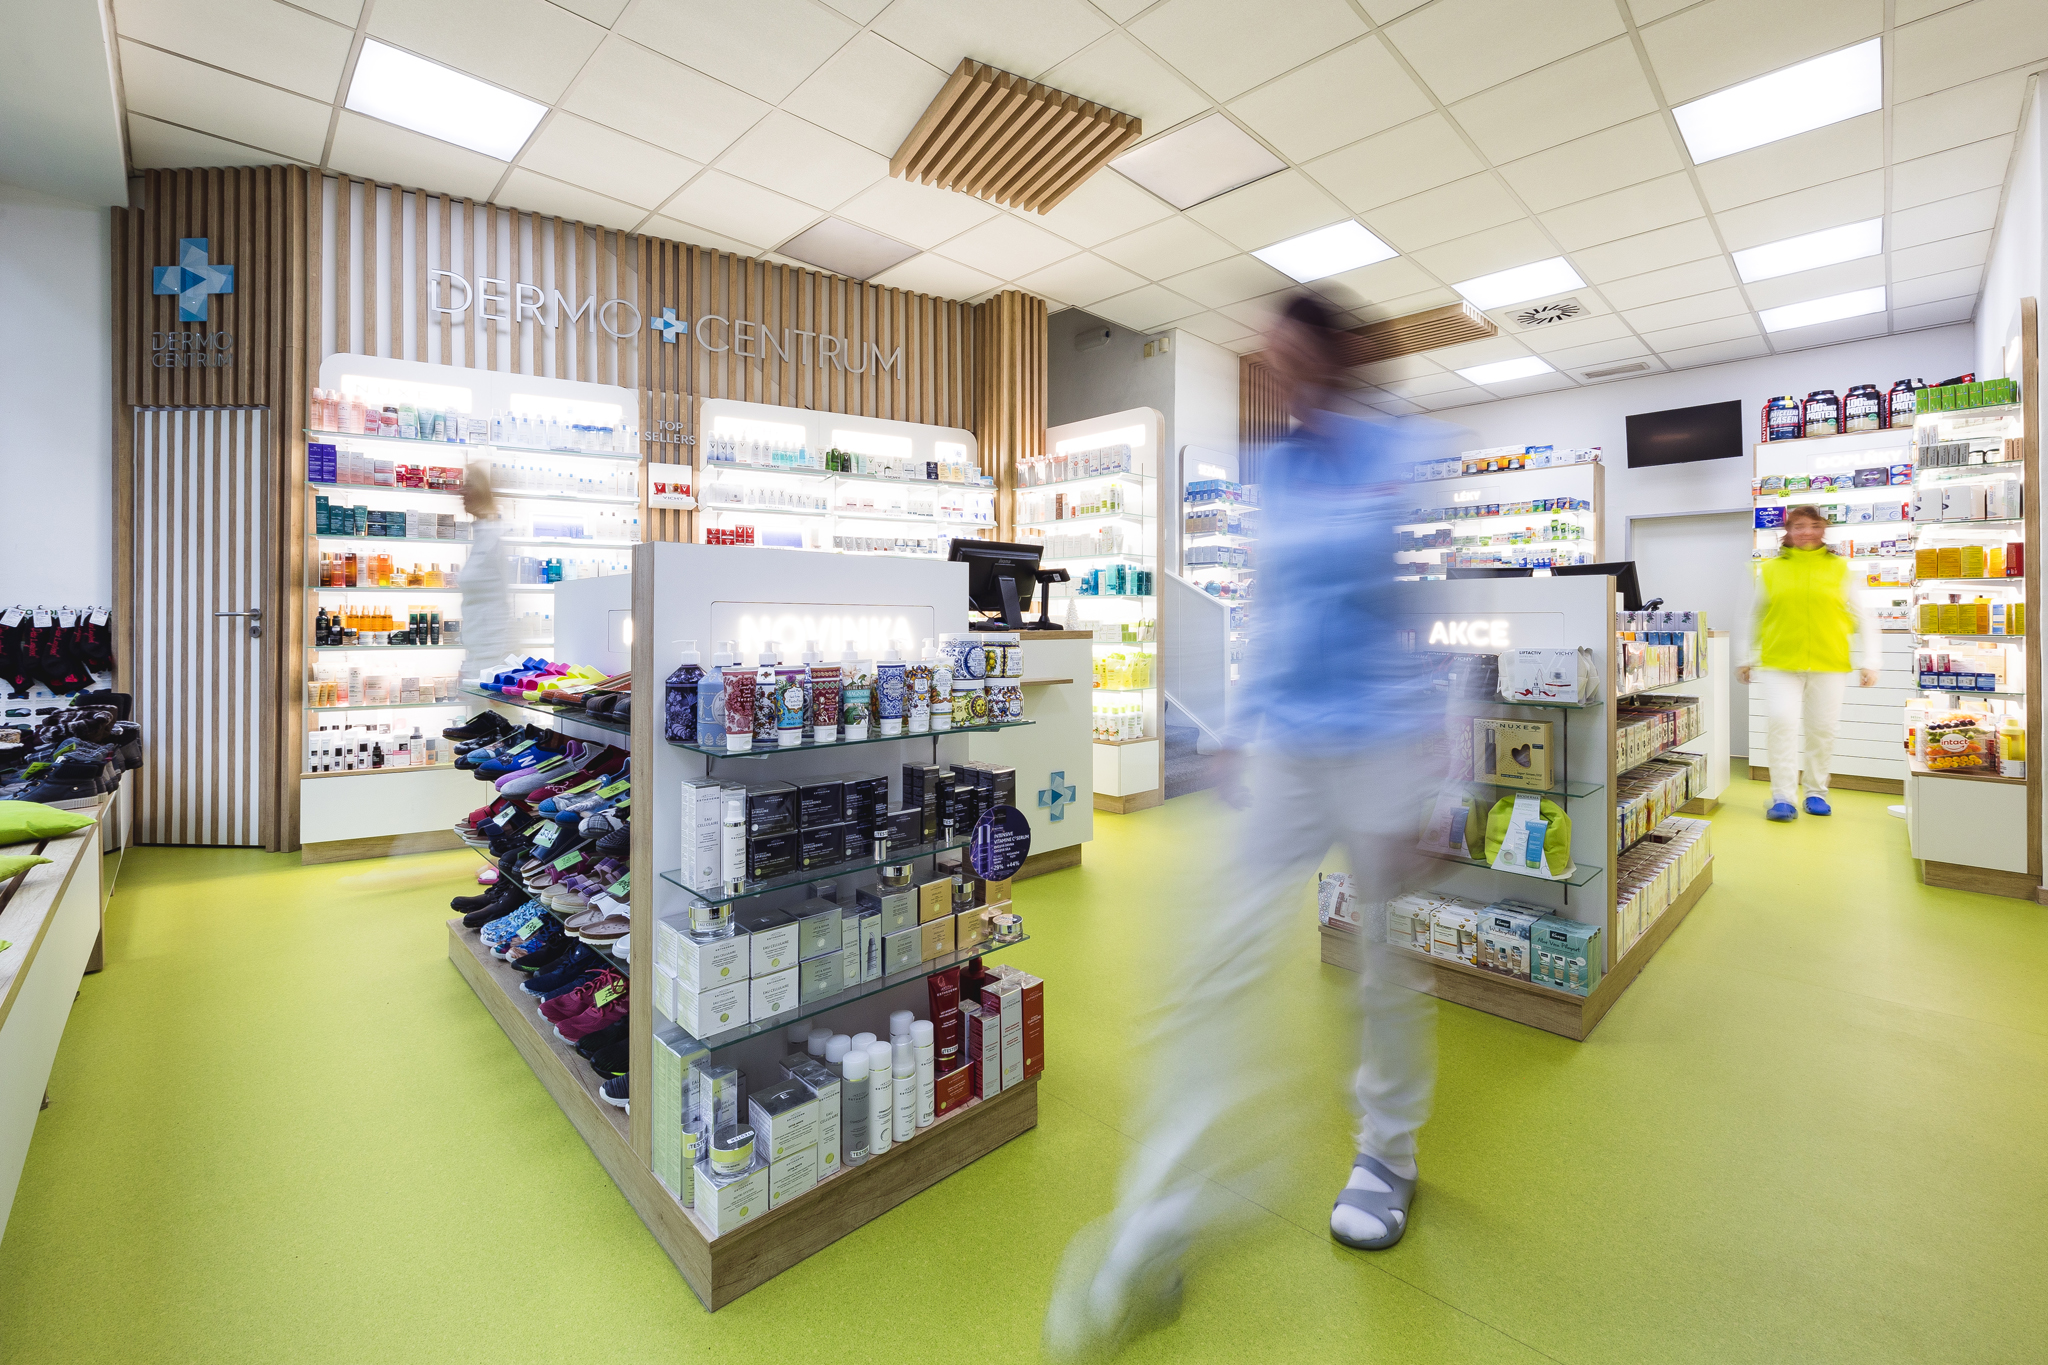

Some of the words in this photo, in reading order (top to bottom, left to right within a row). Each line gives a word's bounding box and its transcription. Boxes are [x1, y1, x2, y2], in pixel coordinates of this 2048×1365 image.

[431, 268, 642, 339] DERMO
[696, 314, 901, 380] CENTRUM
[153, 331, 233, 351] DERMO
[152, 353, 233, 368] CENTRUM
[1807, 411, 1837, 420] PROTEIN
[1846, 405, 1878, 416] PROTEIN
[657, 420, 684, 432] TOP
[644, 431, 696, 445] SELLERS
[1816, 450, 1903, 469] DOPLŇKY
[1454, 491, 1481, 502] LÉKY
[739, 614, 914, 652] NOVINKA
[1429, 621, 1510, 646] AKCE
[1941, 738, 1970, 746] intact
